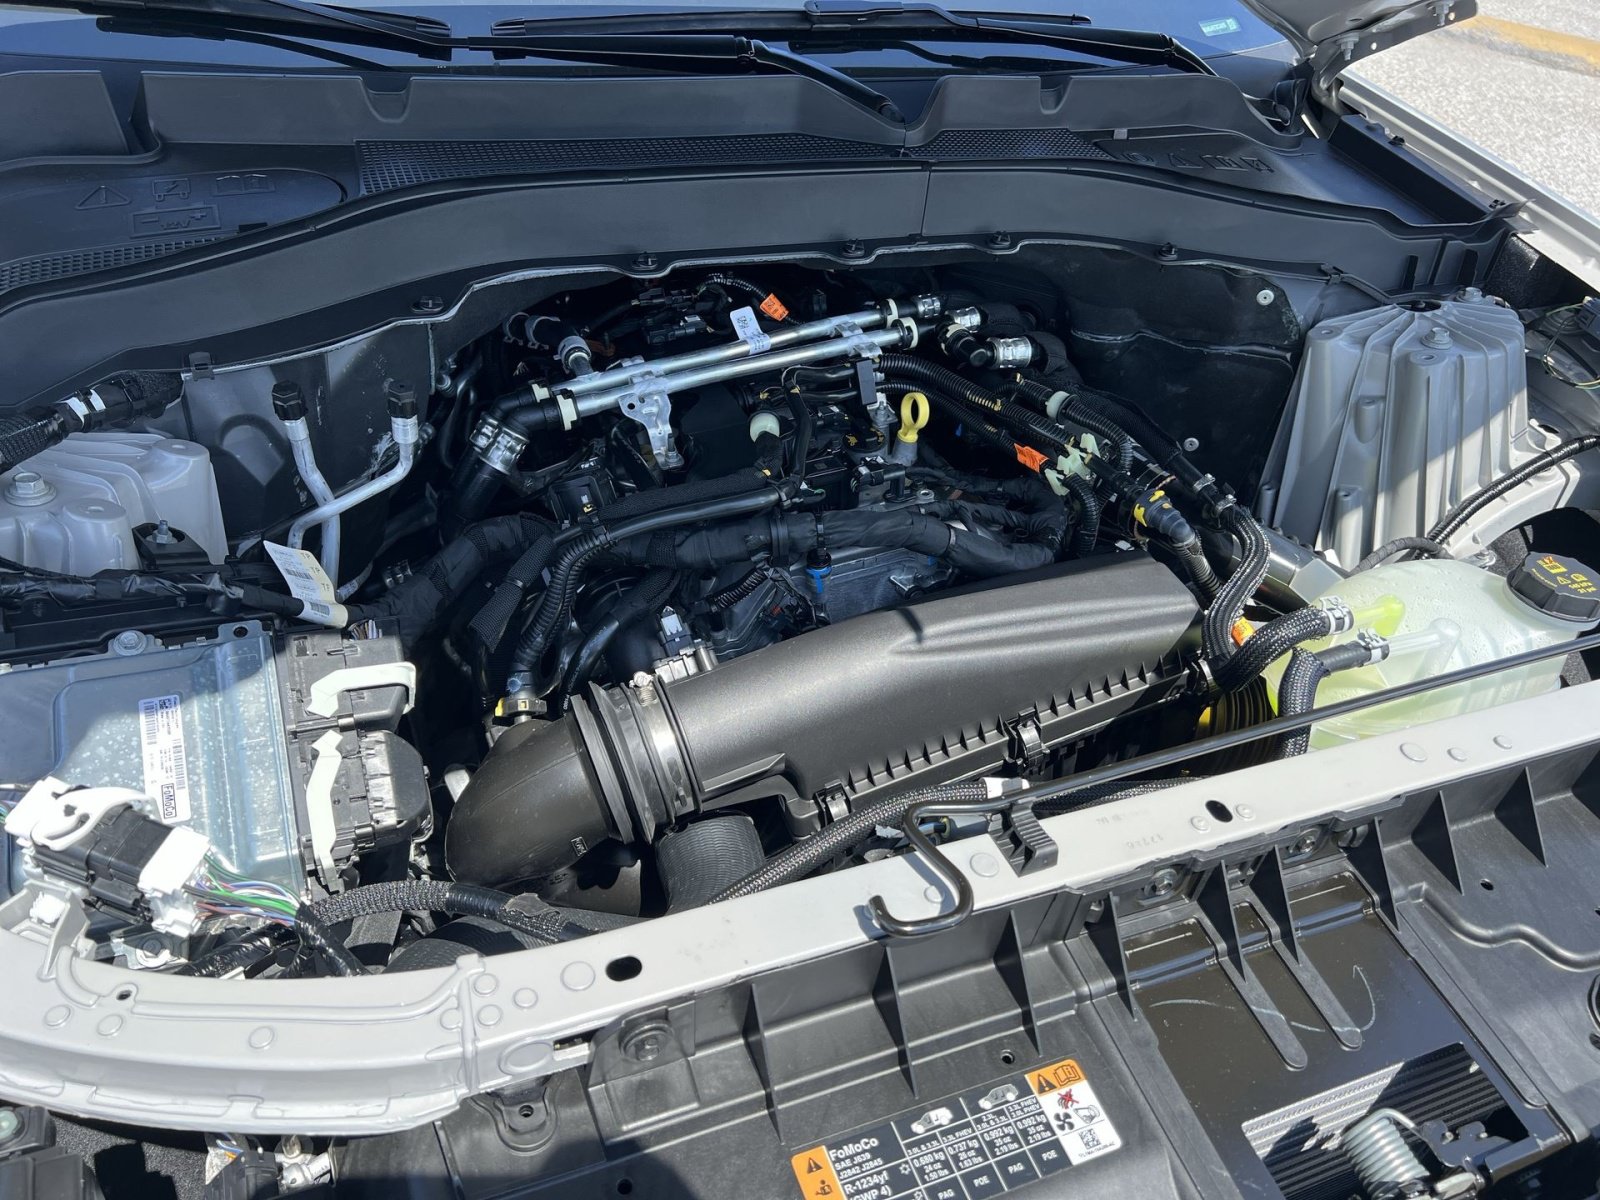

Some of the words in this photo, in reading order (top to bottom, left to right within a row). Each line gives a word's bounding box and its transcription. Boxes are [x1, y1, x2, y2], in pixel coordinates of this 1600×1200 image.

[163, 785, 175, 817] FoMoCo
[1016, 1116, 1037, 1130] 0.992
[1035, 1114, 1047, 1124] kg
[983, 1127, 1004, 1141] 0.992
[1002, 1125, 1015, 1135] kg
[1027, 1126, 1036, 1134] 35
[1035, 1124, 1045, 1132] oz
[993, 1138, 1003, 1147] 35
[1002, 1135, 1012, 1143] oz
[1040, 1131, 1052, 1140] lbs
[828, 1137, 879, 1161] FoMoCo
[947, 1141, 967, 1155] 0.737
[966, 1139, 979, 1149] kg
[1007, 1142, 1020, 1151] lbs
[913, 1154, 934, 1167] 0.680
[933, 1151, 946, 1161] kg
[967, 1149, 976, 1157] oz
[1041, 1149, 1058, 1161] POE
[834, 1158, 853, 1171] SAE
[853, 1152, 871, 1165] J639
[972, 1156, 983, 1165] lbs
[839, 1165, 861, 1180] J2842
[861, 1157, 883, 1171] J2845
[923, 1164, 933, 1173] 24
[933, 1162, 942, 1170] oz
[1007, 1162, 1025, 1174] PAG
[924, 1171, 939, 1181] 1.50
[937, 1168, 950, 1177] lbs
[843, 1170, 889, 1195] R-1234yf
[973, 1175, 990, 1187] POE
[880, 1184, 892, 1197] 4)
[937, 1188, 955, 1200] PAG
